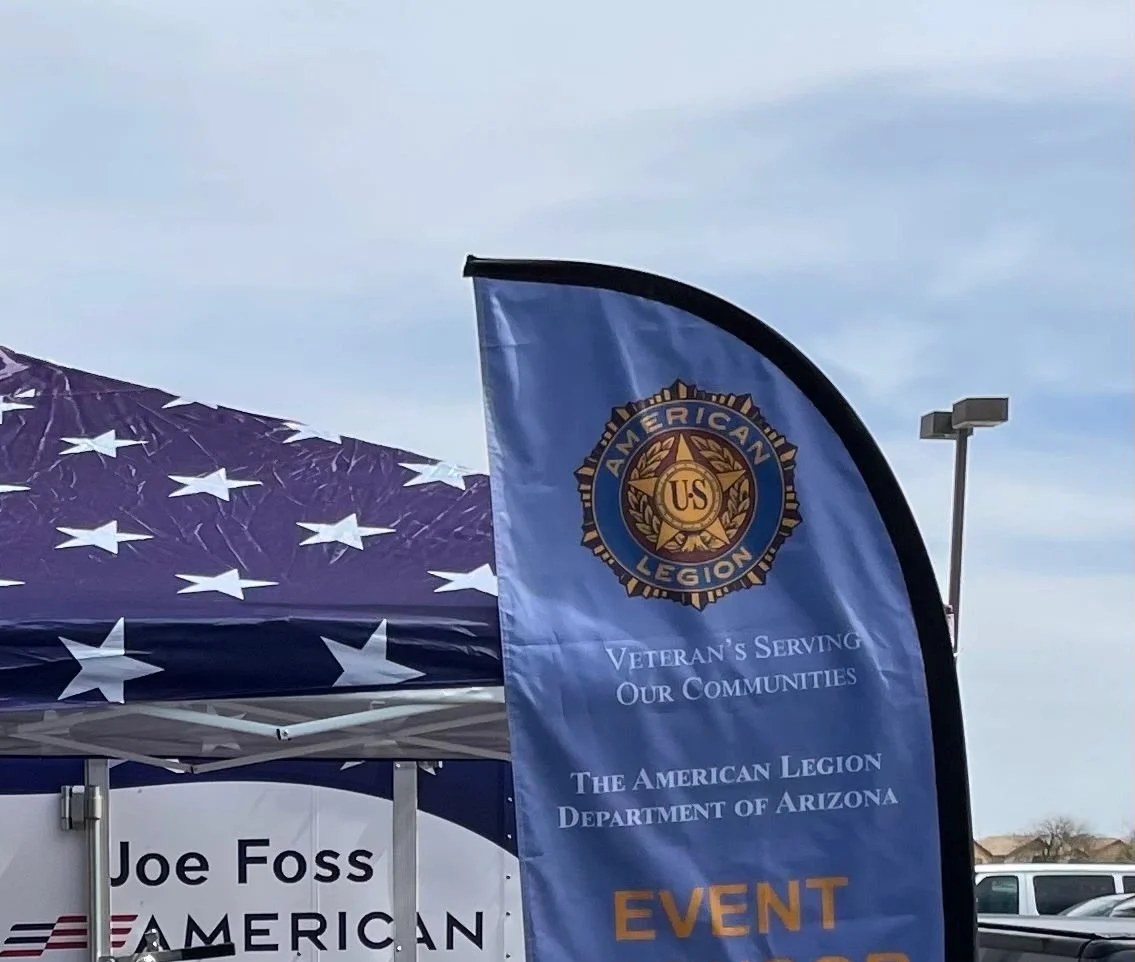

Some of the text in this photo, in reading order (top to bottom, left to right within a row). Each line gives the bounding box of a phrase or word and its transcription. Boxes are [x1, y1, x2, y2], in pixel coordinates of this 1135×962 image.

[605, 406, 771, 478] AMERICAN
[636, 546, 752, 586] LEGION
[606, 632, 862, 671] VETERAN'S SERVING
[616, 667, 856, 706] OUR COMMUNITIES
[571, 752, 881, 795] THE AMERICAN LEGION
[558, 787, 898, 829] DEPARTMENT OF ARIZONA
[110, 838, 374, 887] Joe Foss
[612, 876, 848, 941] EVENT
